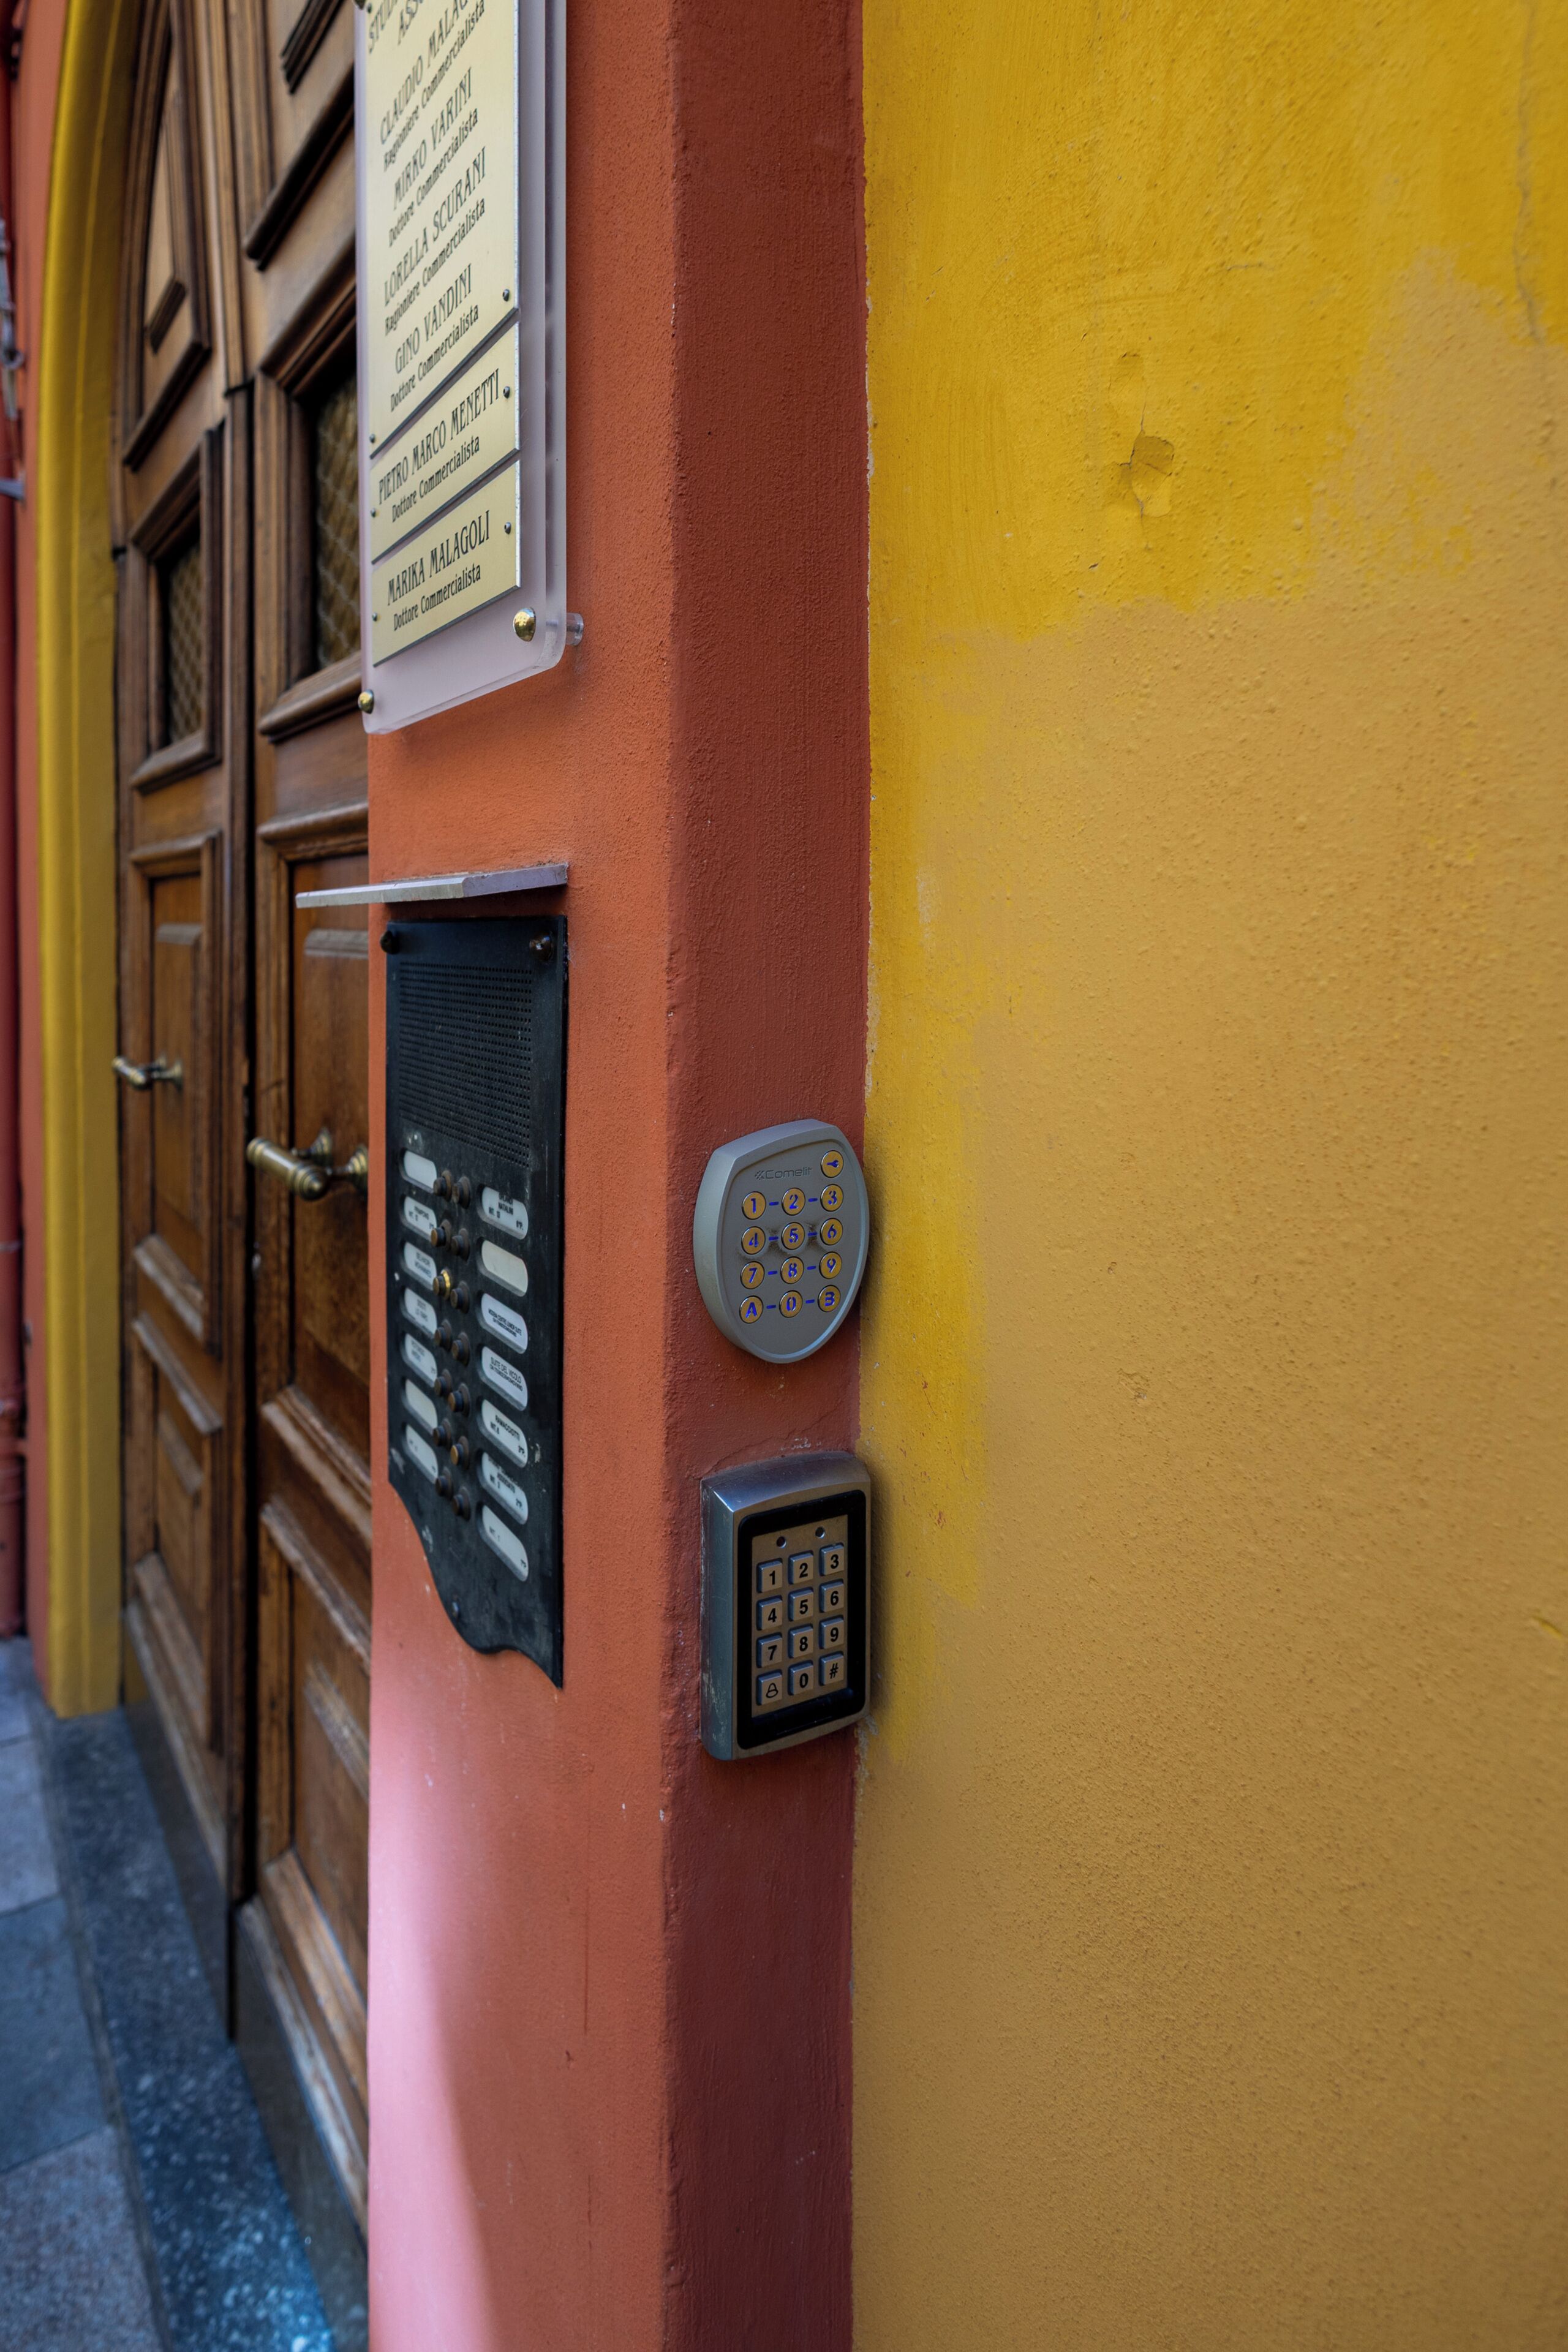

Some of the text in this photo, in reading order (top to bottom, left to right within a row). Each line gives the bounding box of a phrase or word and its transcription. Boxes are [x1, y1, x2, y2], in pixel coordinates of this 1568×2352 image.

[368, 0, 398, 53] STUD
[398, 0, 423, 46] ASS
[421, 0, 484, 108] Commercialista
[380, 55, 423, 145] CLAUDIO
[393, 67, 472, 211] MIRKO VARINI
[388, 108, 478, 247] Dottore Commercialista
[384, 146, 486, 306] LORELLA SCURANI
[385, 198, 485, 336] Ragioniere Commercialista
[395, 263, 472, 374] GINO VANDINI
[390, 304, 479, 412] Dottore Commercialista
[379, 368, 499, 505] PIETRO MARCO MENETTI
[392, 435, 480, 522] Dottore Commercialista
[388, 510, 489, 606] MARIKA MALAGOLI
[393, 563, 481, 631] Dottore Commercialista
[750, 1190, 837, 1213] 1 2 3
[764, 1166, 813, 1180] Comelit
[748, 1224, 837, 1248] 4 5 6
[748, 1258, 837, 1283] 7 8 9
[745, 1302, 758, 1318] A
[786, 1297, 797, 1311] 0
[769, 1554, 839, 1585] 1 2 3
[767, 1590, 839, 1623] 4 5 6
[767, 1627, 839, 1661] 7 8 9
[799, 1673, 809, 1689] 0
